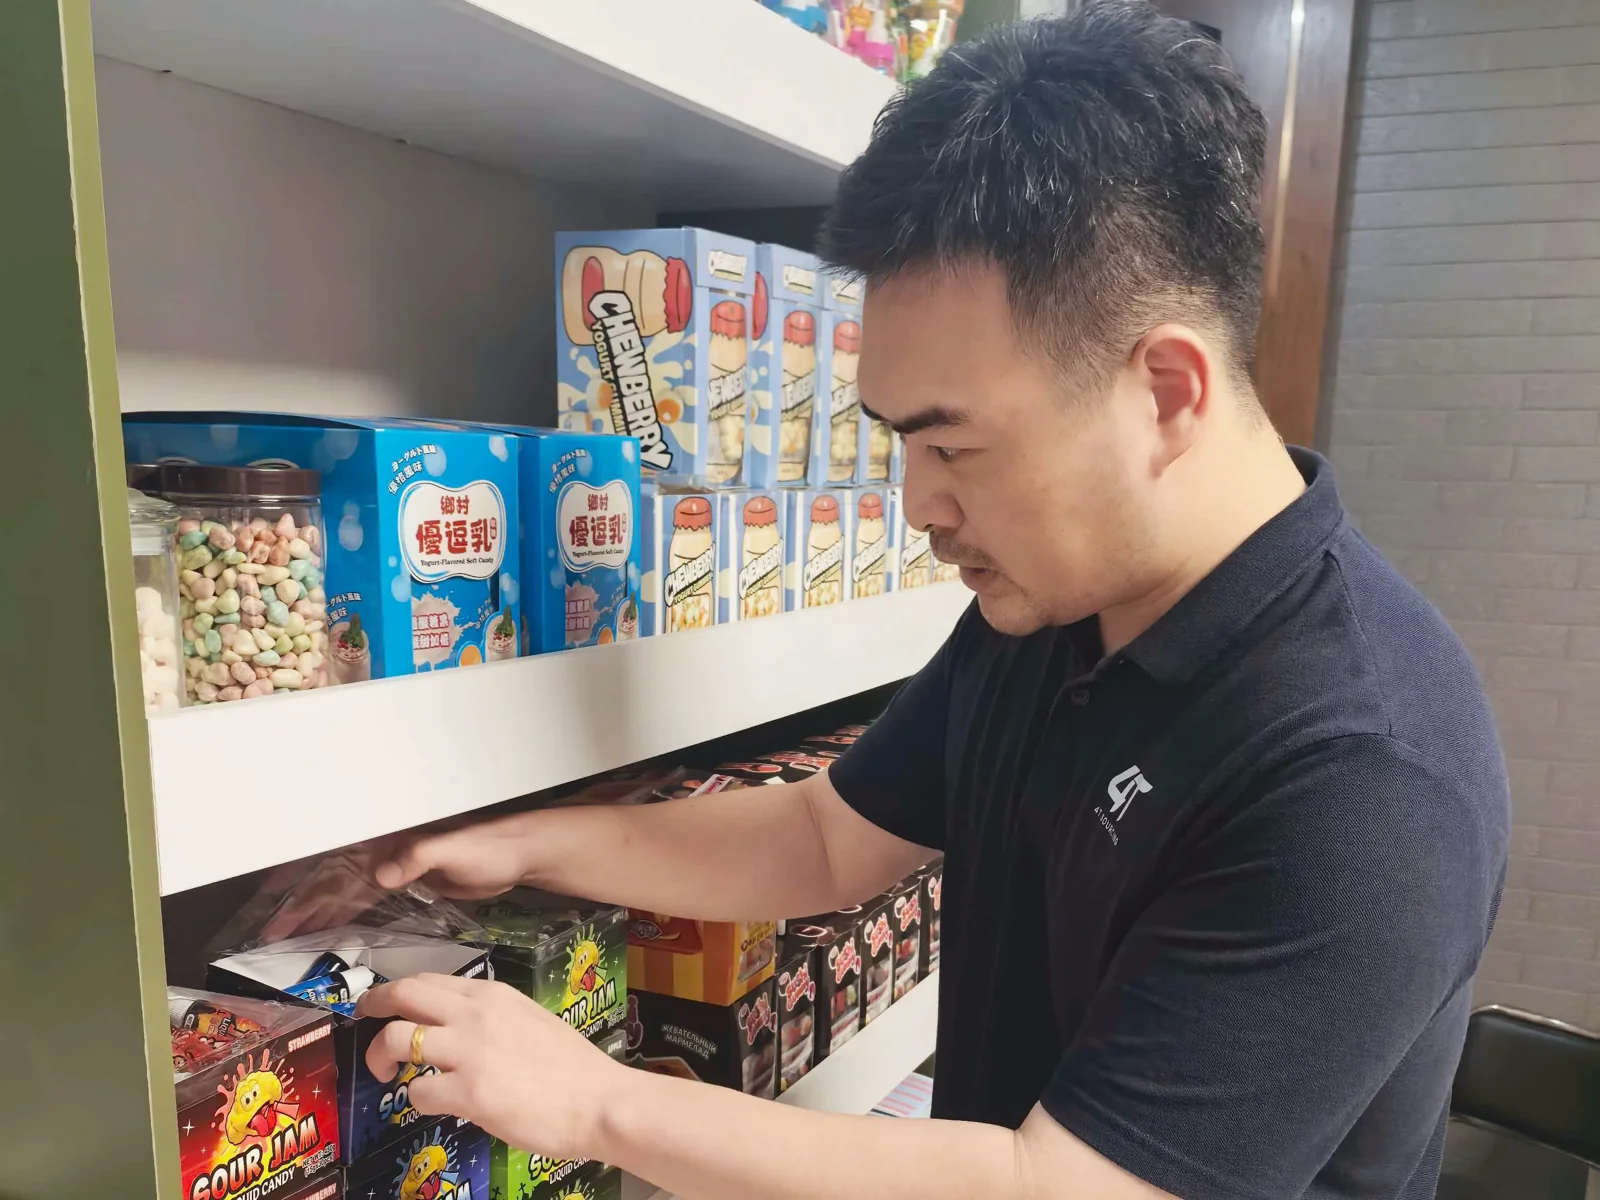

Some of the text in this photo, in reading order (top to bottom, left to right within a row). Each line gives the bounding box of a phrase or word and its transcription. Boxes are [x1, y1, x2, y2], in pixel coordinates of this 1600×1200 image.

[589, 291, 673, 469] CHEWBERRY
[415, 518, 493, 555] 優逗乳
[562, 998, 588, 1028] OUR
[590, 980, 616, 1018] JAM
[288, 1023, 332, 1052] STRAWBERRY
[662, 1024, 717, 1054] ЖЕВАТЕЛЬНЫЙ
[665, 1033, 709, 1059] МАРМЕЛАД
[191, 1114, 319, 1200] SOUR JAM
[261, 1165, 295, 1196] CANDY
[549, 1163, 573, 1185] LIQUID
